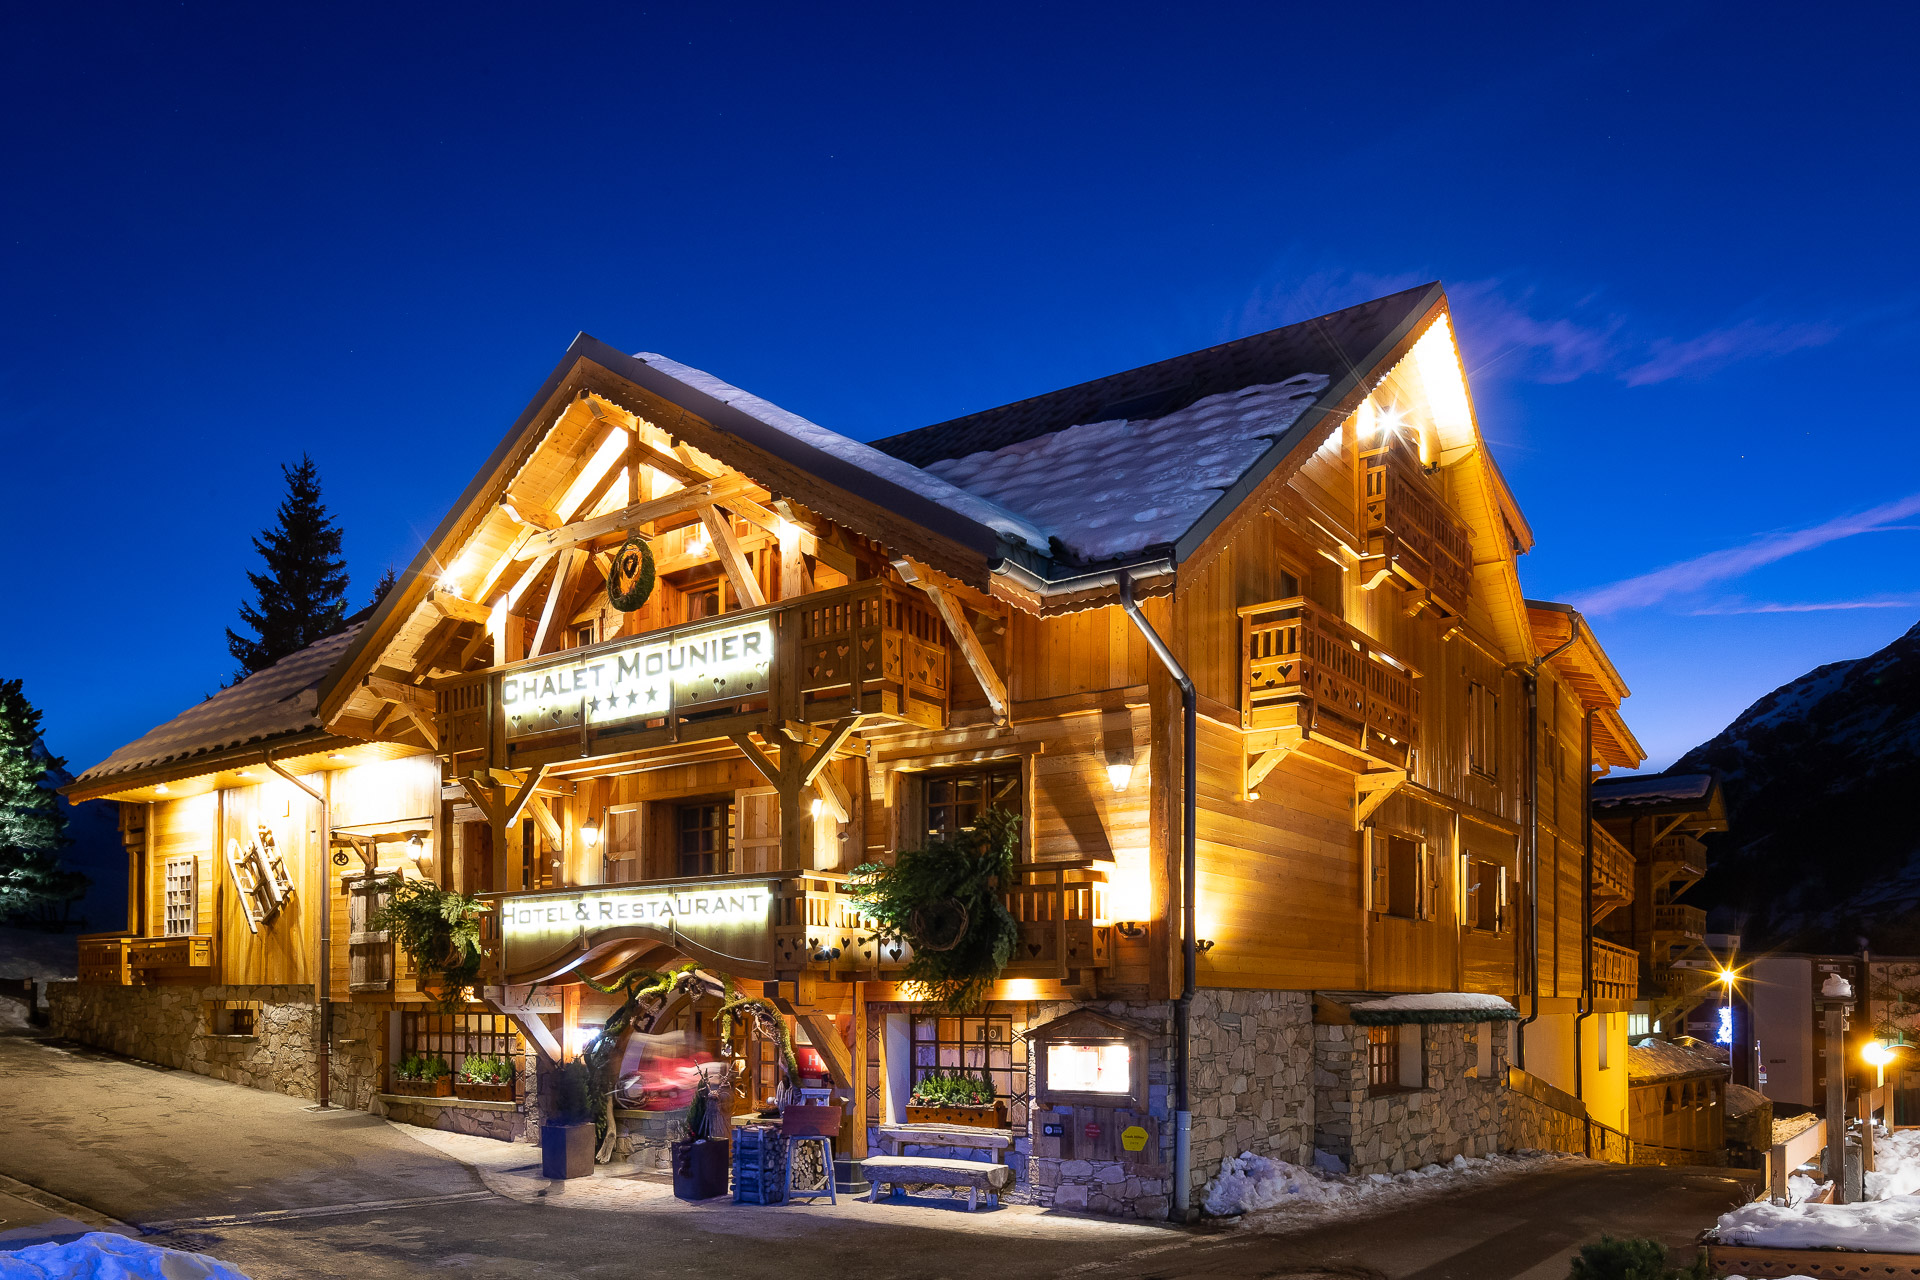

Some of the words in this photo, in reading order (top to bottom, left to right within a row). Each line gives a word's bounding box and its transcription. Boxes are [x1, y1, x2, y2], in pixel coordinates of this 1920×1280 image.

[502, 664, 605, 706] CHALET
[617, 631, 762, 683] MOUNIER
[502, 906, 570, 925] HOTEL
[575, 902, 590, 921] &
[599, 894, 763, 920] RESTAURANT
[808, 1054, 819, 1066] H
